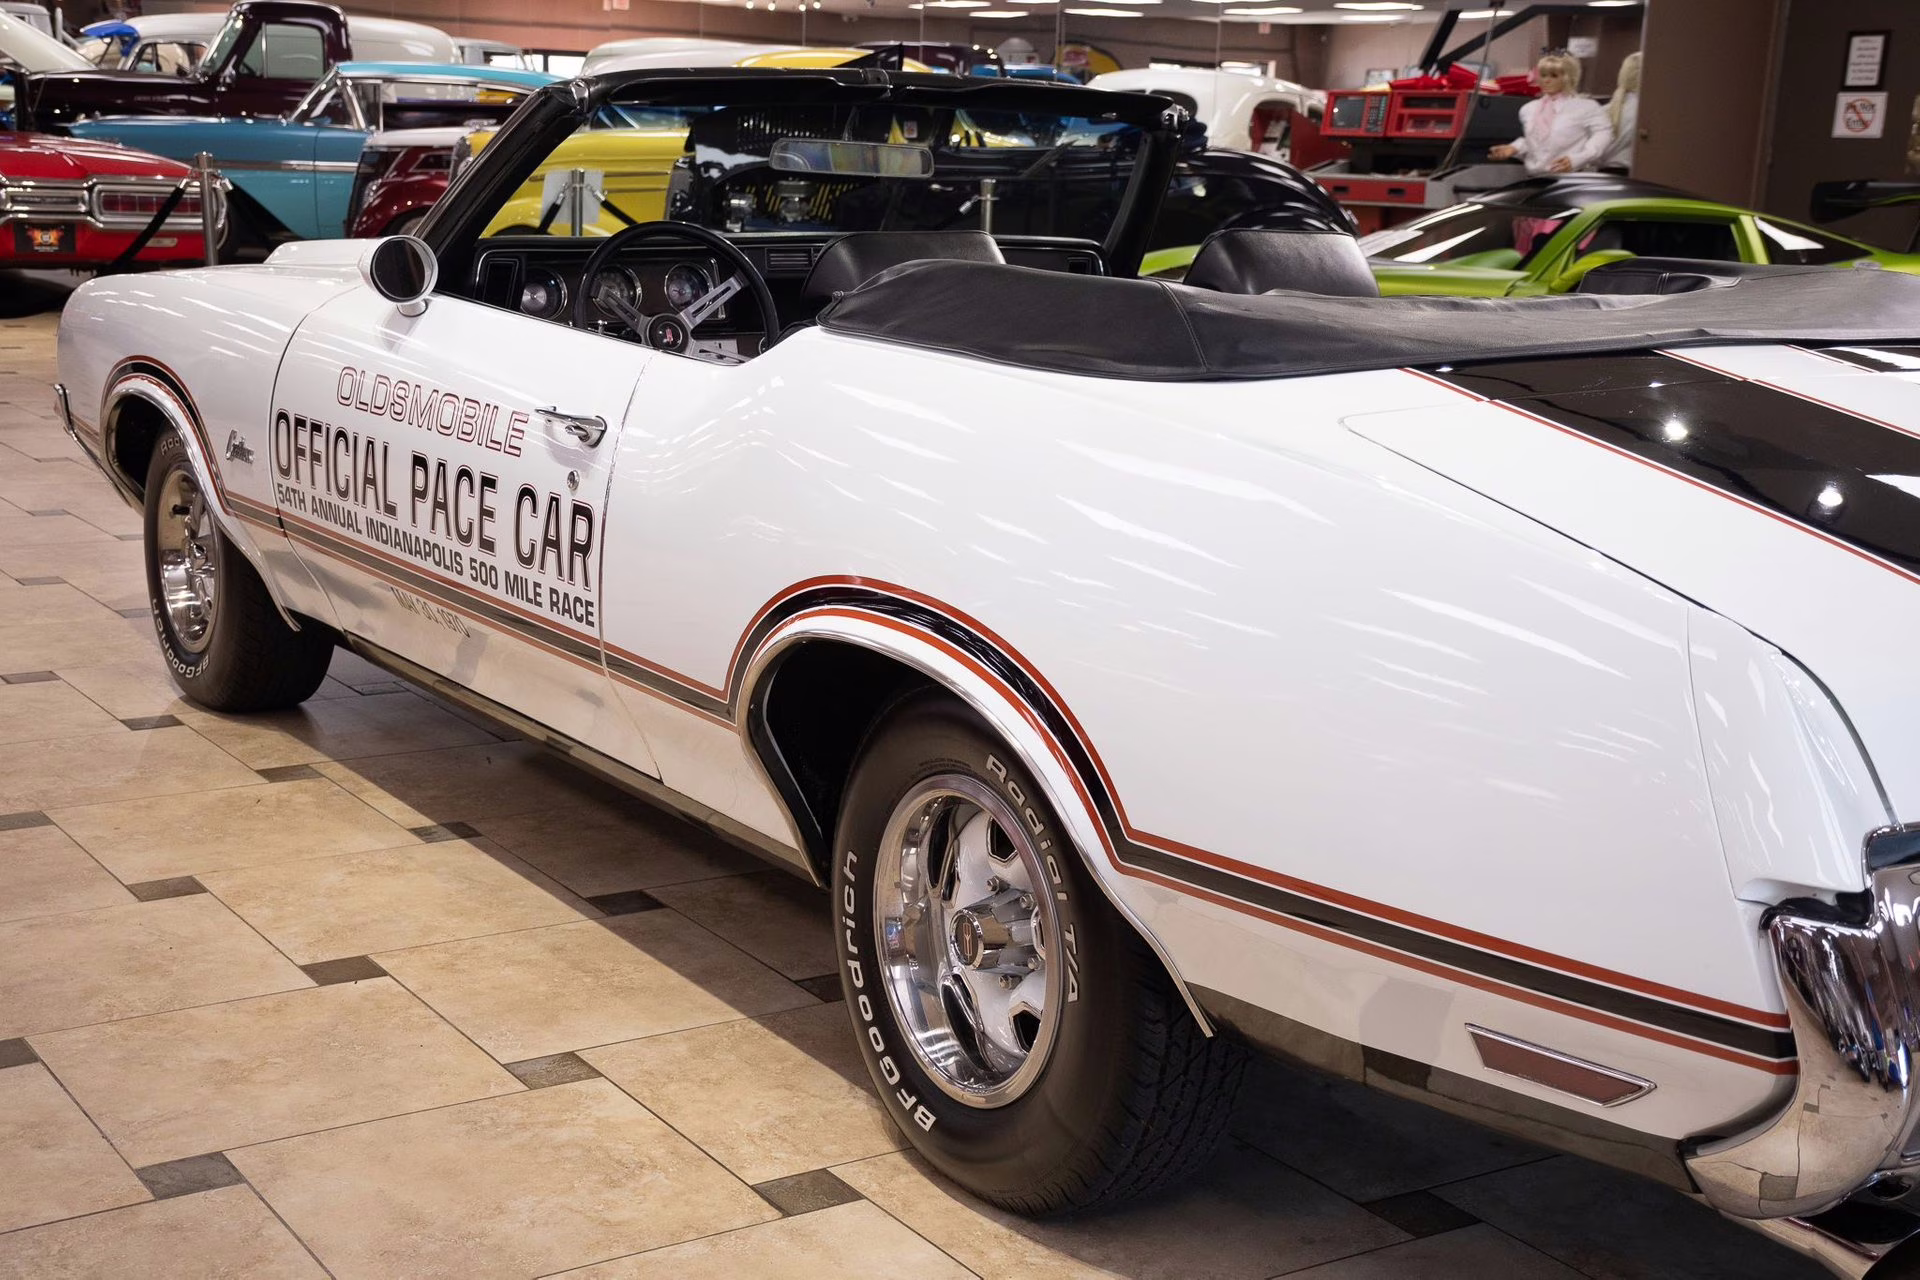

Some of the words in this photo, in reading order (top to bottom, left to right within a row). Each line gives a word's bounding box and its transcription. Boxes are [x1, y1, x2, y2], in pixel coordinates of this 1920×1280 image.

[337, 366, 529, 458] OLDSMOBILE
[275, 407, 399, 522] OFFICIAL
[410, 451, 499, 557] PACE
[514, 483, 595, 592] CAR
[276, 482, 308, 514] 54TH
[311, 496, 363, 535] ANNUAL
[365, 515, 464, 577] INDIANAPOLIS
[469, 558, 499, 590] 500
[504, 569, 543, 608] MILE
[549, 587, 595, 628] RACE
[152, 598, 209, 678] BFGoodrich
[986, 754, 1069, 902] Radial
[1064, 923, 1080, 1004] T/A
[842, 850, 937, 1132] BFGoodrich
